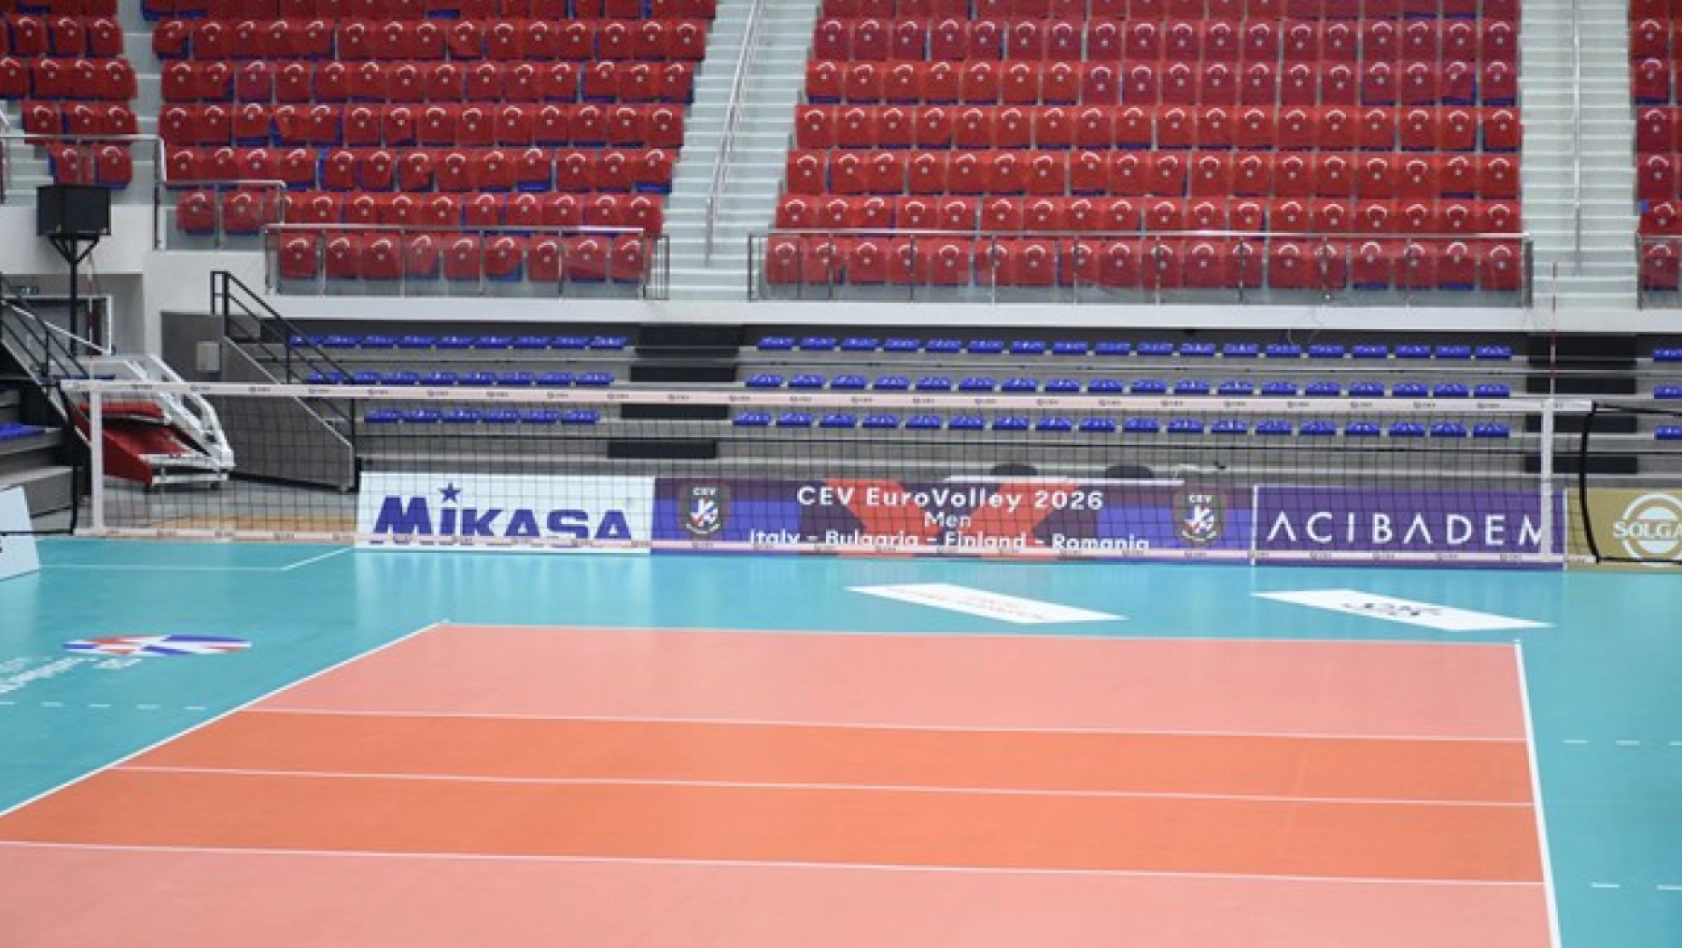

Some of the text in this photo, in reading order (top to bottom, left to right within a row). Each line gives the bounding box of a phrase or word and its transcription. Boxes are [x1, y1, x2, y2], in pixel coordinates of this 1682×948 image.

[797, 486, 1104, 513] CEV EuroVolley 2026
[924, 510, 972, 528] Men
[750, 528, 801, 545] Italy
[944, 530, 1026, 548] Finland
[1051, 532, 1150, 550] Romania
